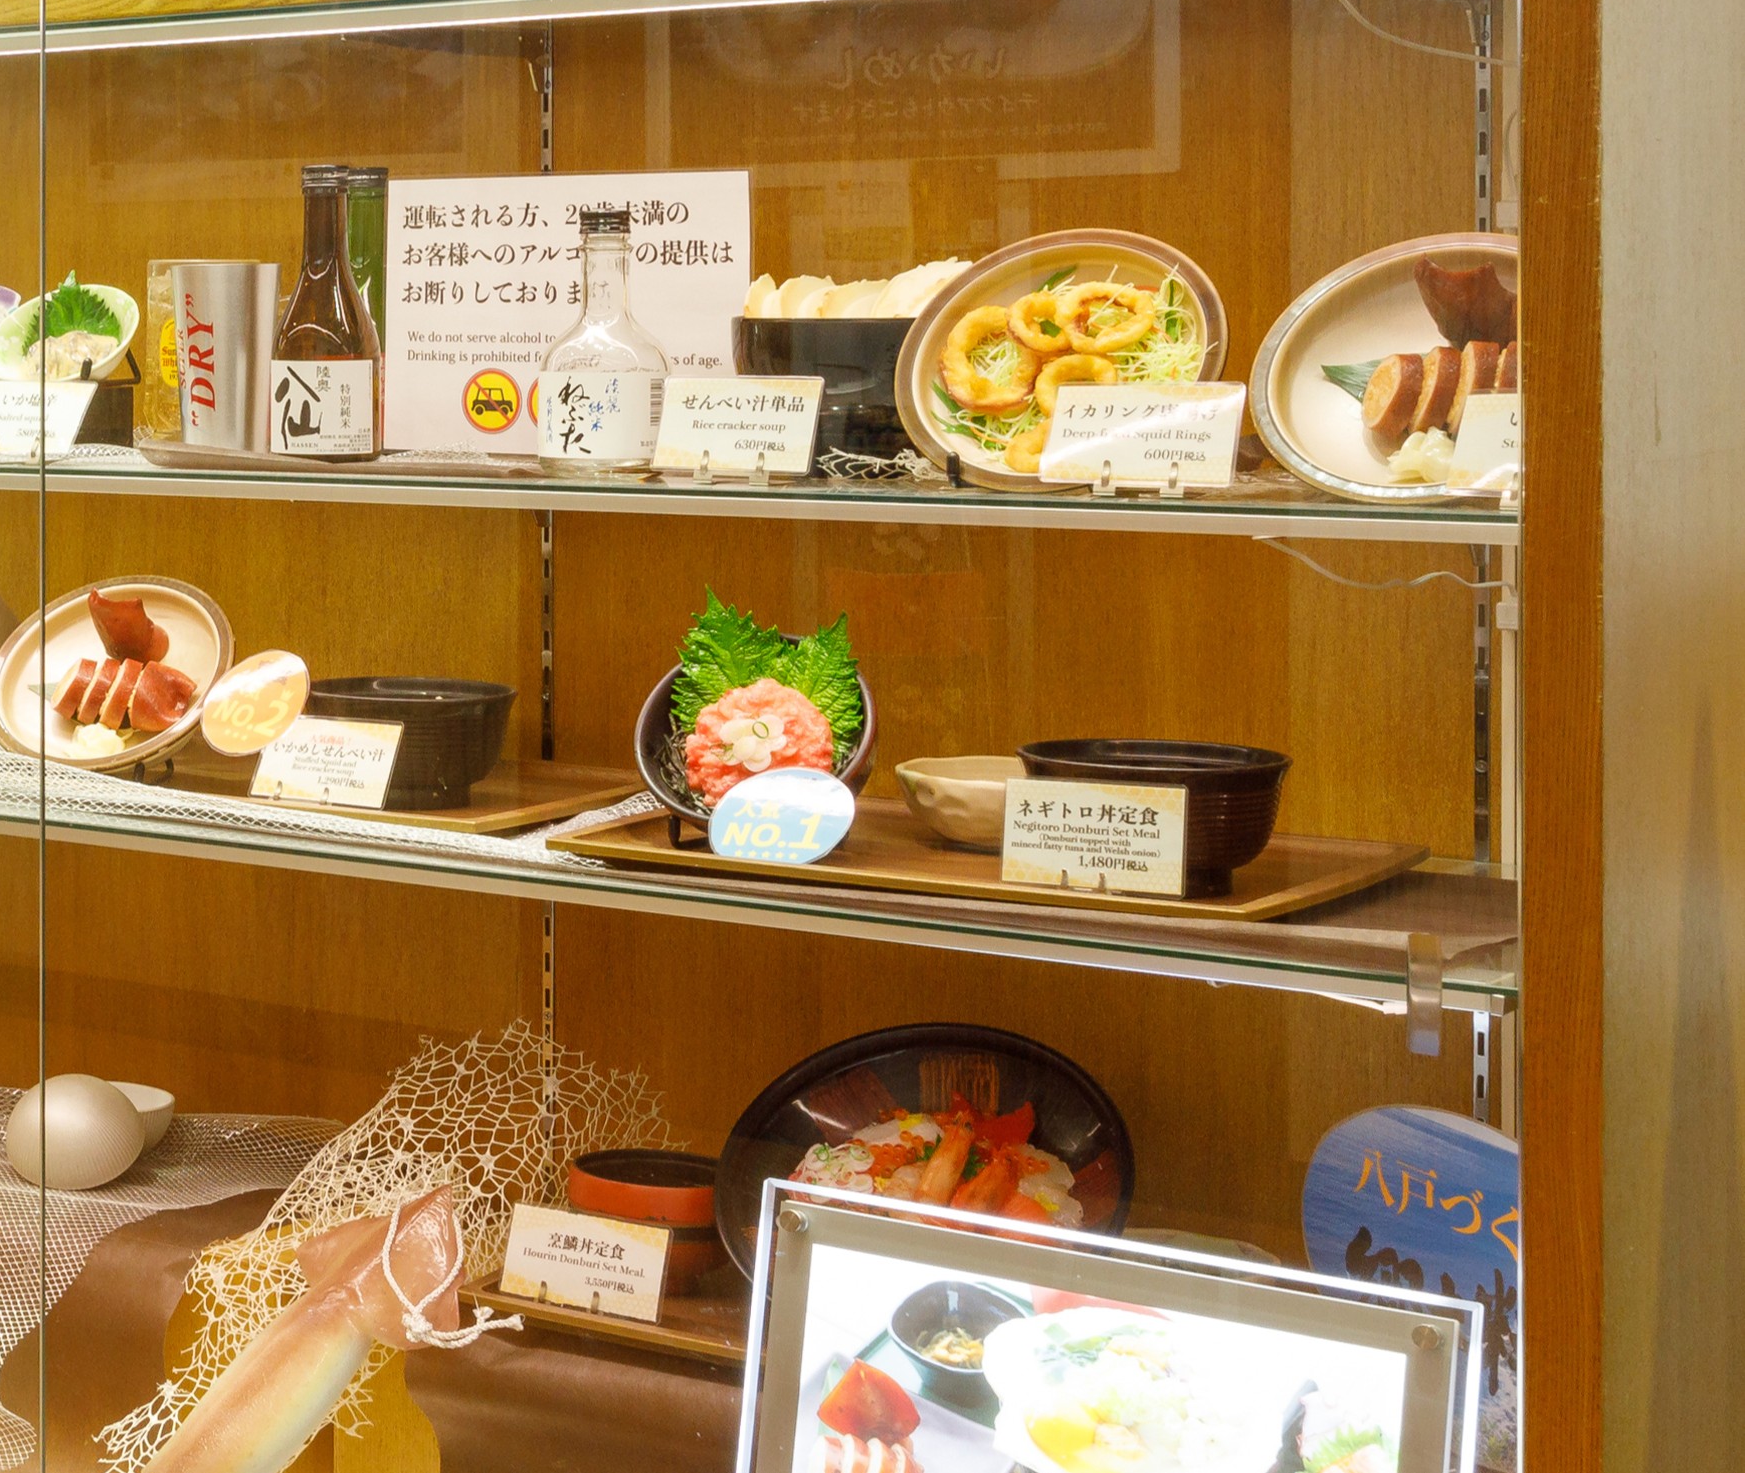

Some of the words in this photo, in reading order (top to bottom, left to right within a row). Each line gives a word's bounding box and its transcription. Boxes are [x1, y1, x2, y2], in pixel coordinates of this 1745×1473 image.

[402, 240, 735, 267] お客様へのアルコの提供は
[402, 280, 582, 306] お断りしておりま
[408, 331, 423, 345] We
[425, 331, 438, 345] do
[441, 331, 462, 345] not
[466, 333, 497, 345] serve
[501, 331, 542, 345] alcohol
[408, 349, 455, 365] Drinking
[458, 350, 468, 363] is
[471, 349, 529, 366] prohibited
[683, 354, 695, 366] of
[698, 357, 723, 370] age.
[315, 365, 332, 393] 陸奥
[340, 383, 351, 429] 特別純米
[558, 376, 591, 454] ねぶた
[681, 394, 806, 415] せんべい汁単品
[692, 420, 713, 431] Rice
[716, 420, 755, 432] cracker
[757, 422, 786, 435] soup
[1132, 429, 1172, 443] Squid
[1174, 429, 1212, 443] Rings
[734, 439, 787, 453] 630円税込
[1143, 447, 1207, 462] 600円税込
[211, 699, 290, 738] NO.2
[273, 740, 386, 763] いかめしせんべい汁
[1016, 799, 1160, 827] ネギトロ丼定食
[720, 812, 823, 854] NO.1
[1013, 820, 1060, 834] Negitoro
[1063, 823, 1110, 837] Donburi
[1112, 826, 1131, 837] Set
[1133, 827, 1161, 840] Meal
[1011, 839, 1042, 850] minced
[1043, 840, 1063, 853] fatty
[1064, 843, 1084, 853] tuna
[1086, 843, 1103, 854] and
[1105, 845, 1129, 856] Welsh
[1078, 835, 1109, 848] topped
[1111, 837, 1131, 848] with
[1078, 854, 1149, 872] 1,480円税込
[547, 1232, 626, 1261] 烹鱗丼定食
[523, 1247, 558, 1262] Hourin
[559, 1253, 601, 1271] Donburi
[601, 1262, 617, 1273] Set
[584, 1275, 635, 1294] 3,550円税込
